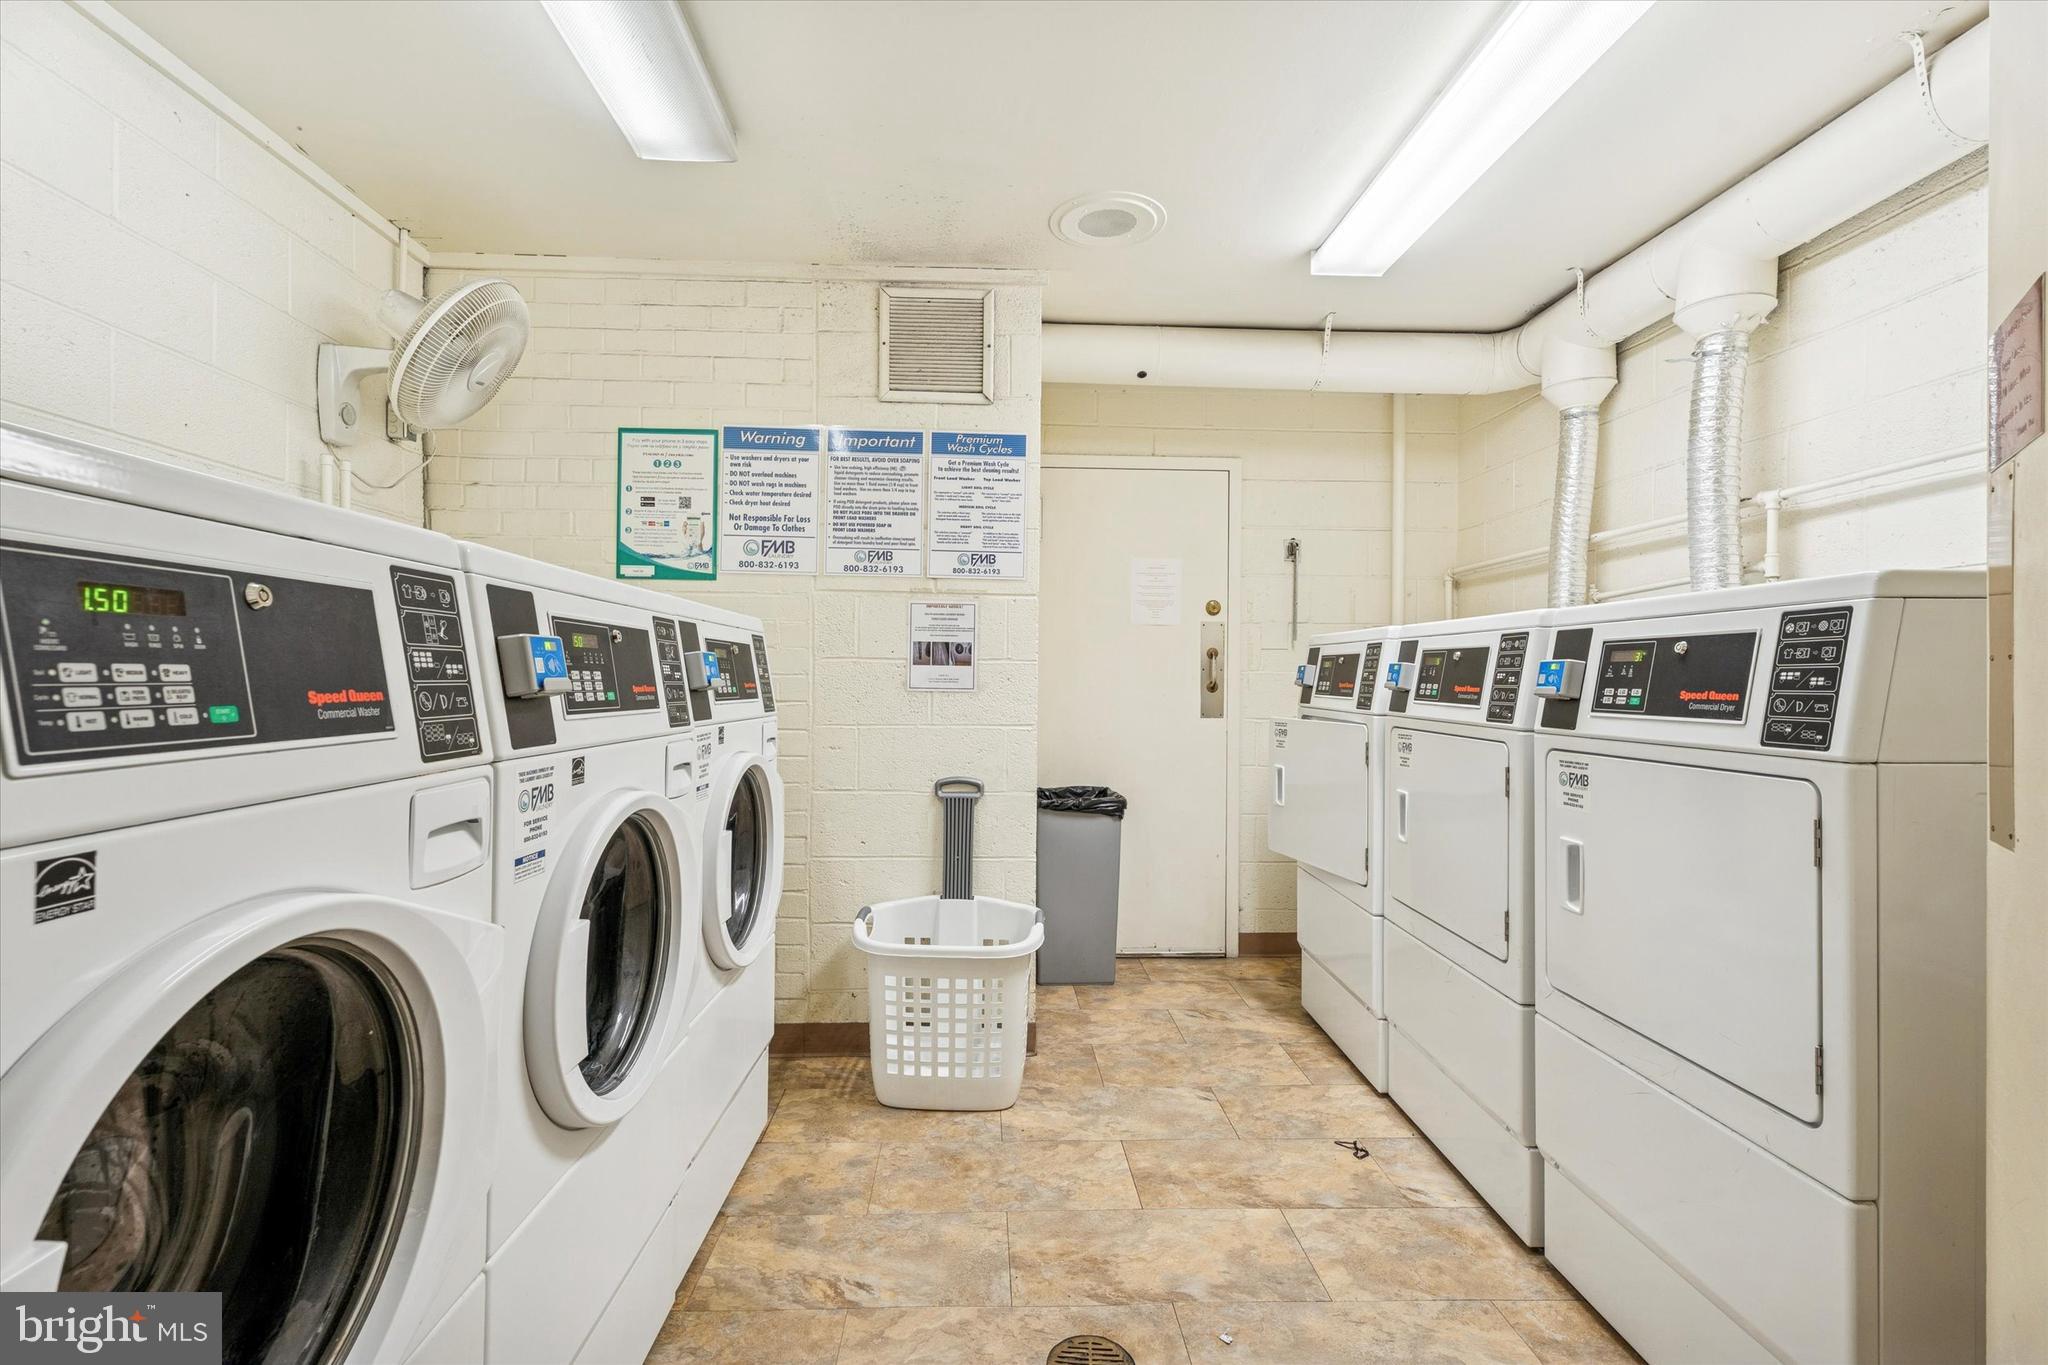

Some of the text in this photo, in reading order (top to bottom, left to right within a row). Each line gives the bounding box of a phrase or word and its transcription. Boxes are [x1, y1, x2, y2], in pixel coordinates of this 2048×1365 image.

[740, 431, 806, 448] Warning
[839, 433, 916, 449] Important
[956, 434, 1003, 444] Premium
[947, 444, 1012, 454] Wash Cycles
[743, 514, 781, 523] Responsible
[744, 524, 770, 533] Damage
[761, 540, 795, 557] FMB
[868, 551, 893, 563] FMB
[971, 554, 996, 567] FMB
[739, 561, 799, 569] 800-832-6193
[844, 565, 904, 573] 800-832-6193
[308, 689, 384, 706] Speed Queen
[1680, 691, 1739, 701] Speed Queen
[318, 707, 380, 719] Commercial Washer
[1689, 702, 1736, 712] Commercial Dryer
[1569, 772, 1589, 788] FMB
[531, 783, 554, 812] FMB
